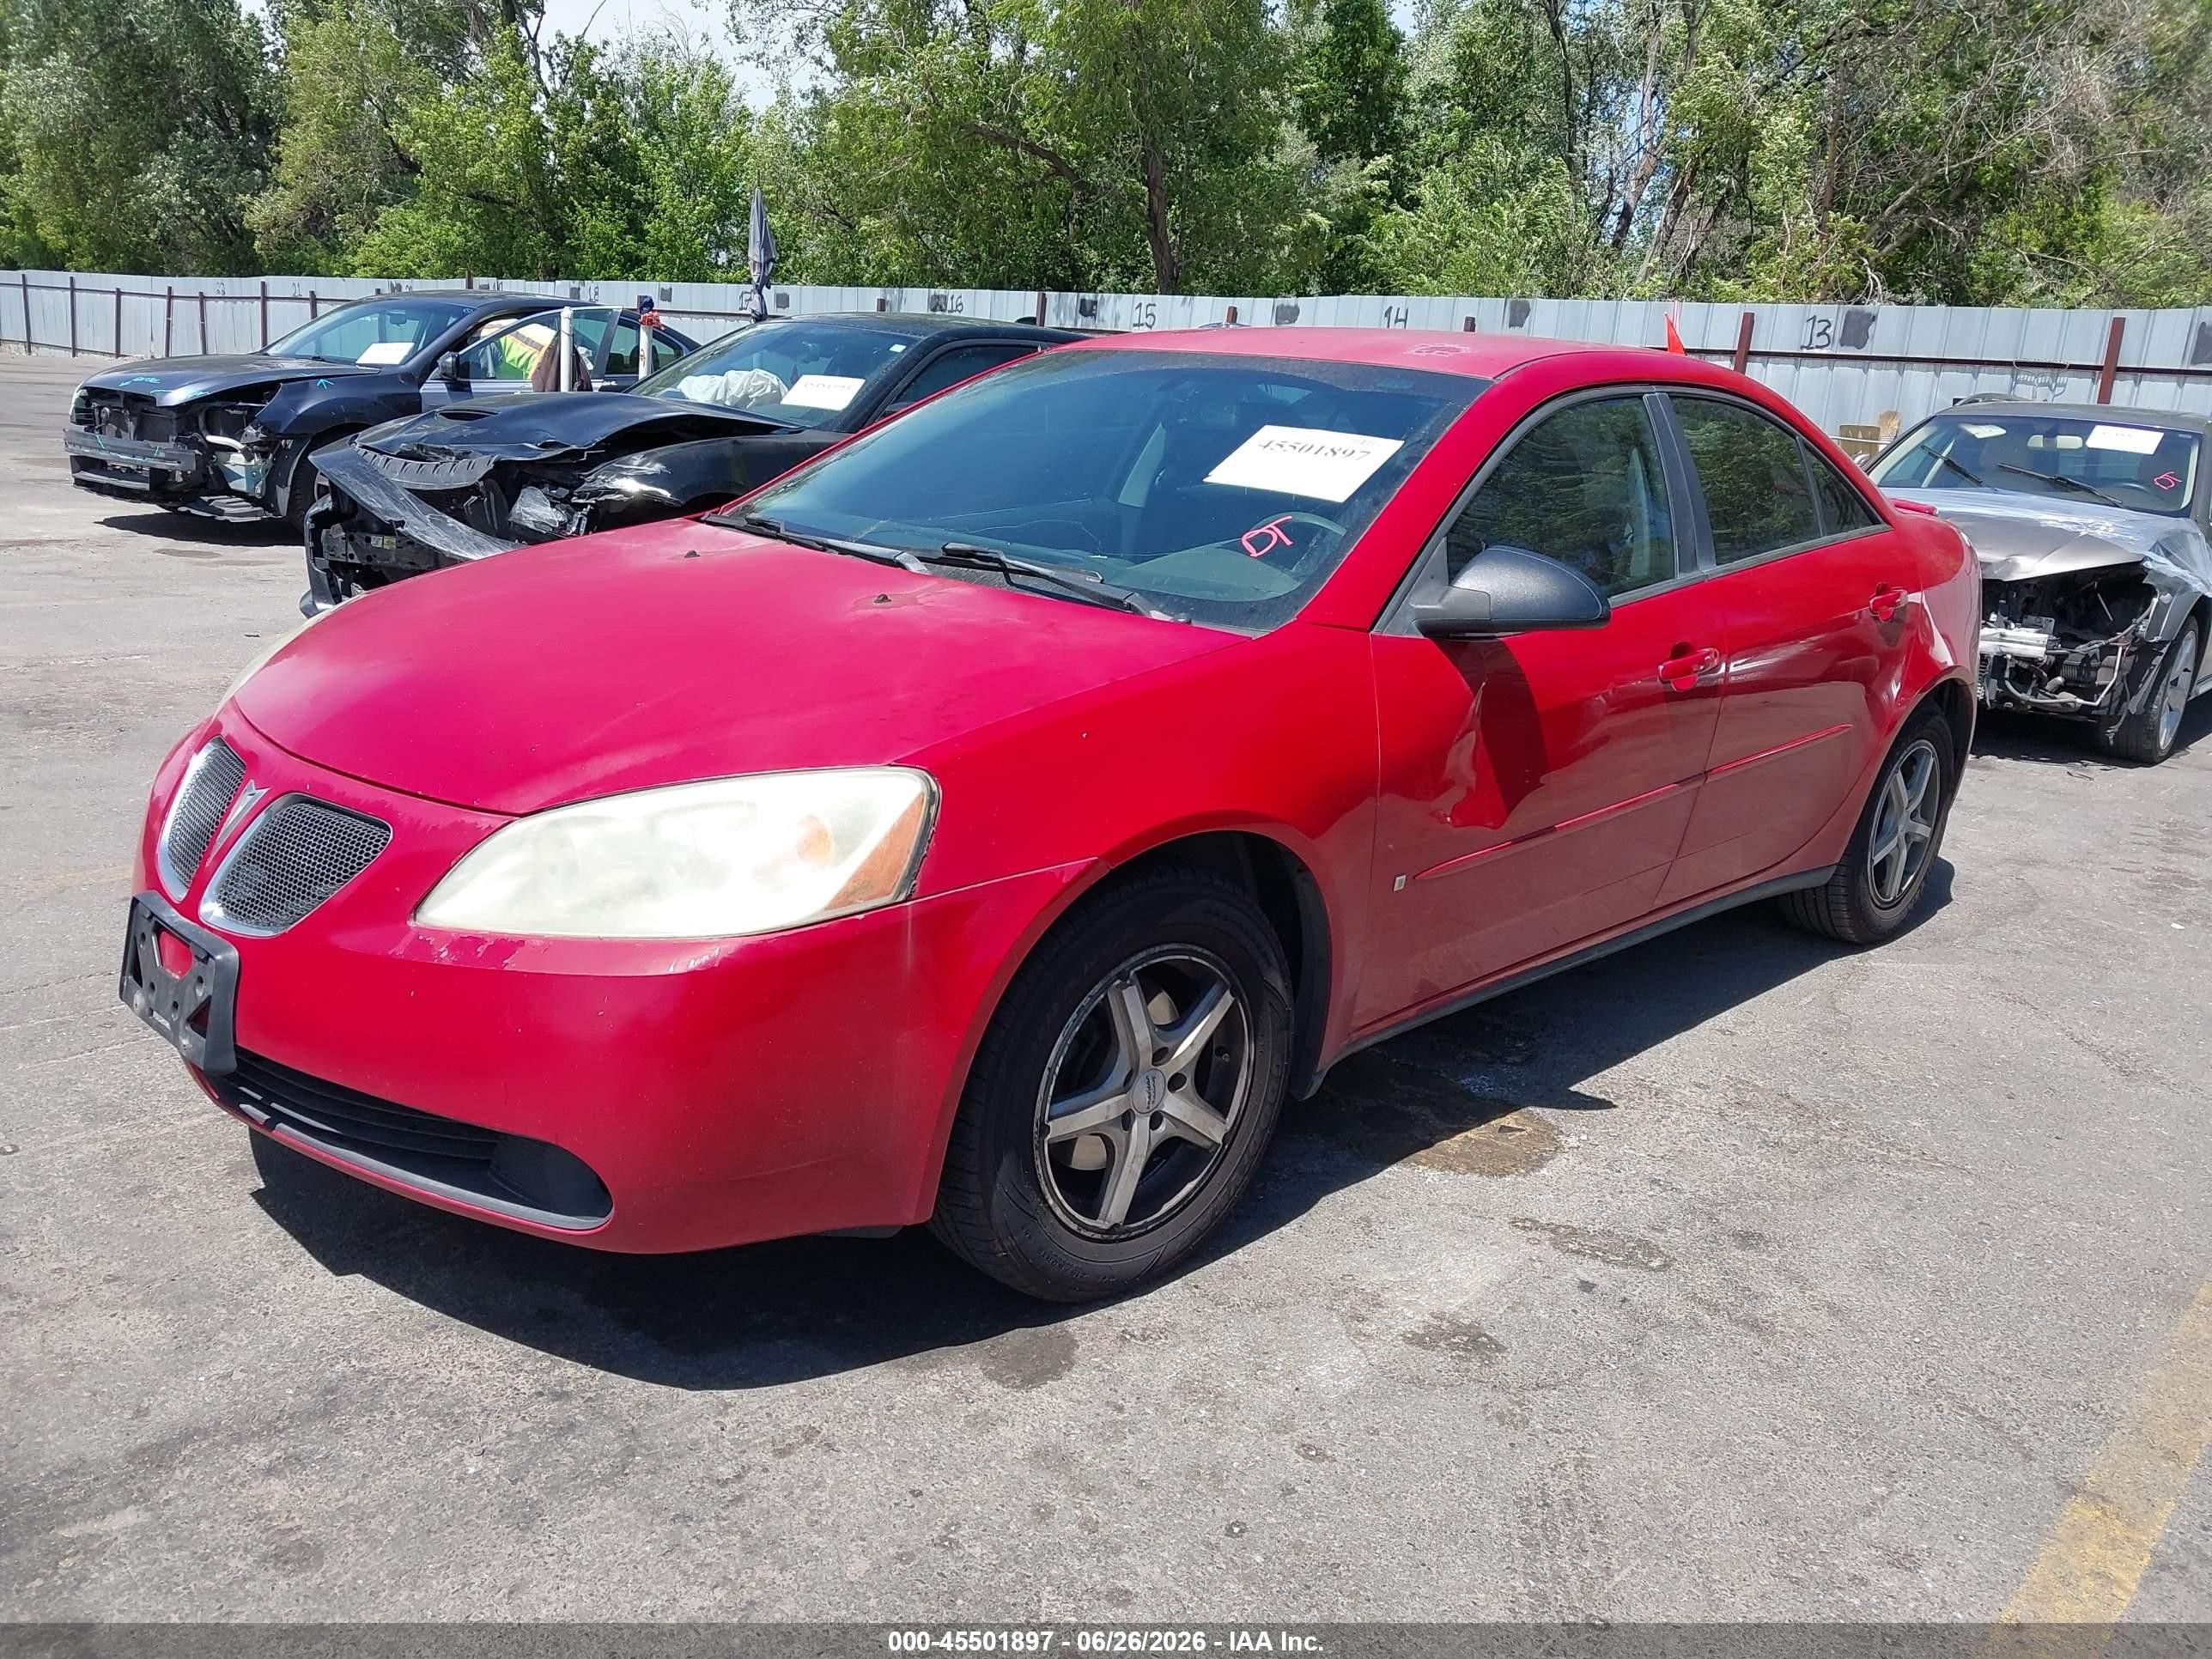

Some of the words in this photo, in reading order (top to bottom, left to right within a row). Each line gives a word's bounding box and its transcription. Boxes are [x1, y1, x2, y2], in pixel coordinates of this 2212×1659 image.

[948, 294, 963, 313] 16
[1133, 302, 1157, 328] 15
[1384, 306, 1408, 329] 14
[1800, 315, 1832, 350] 13
[1258, 439, 1371, 461] 45501897
